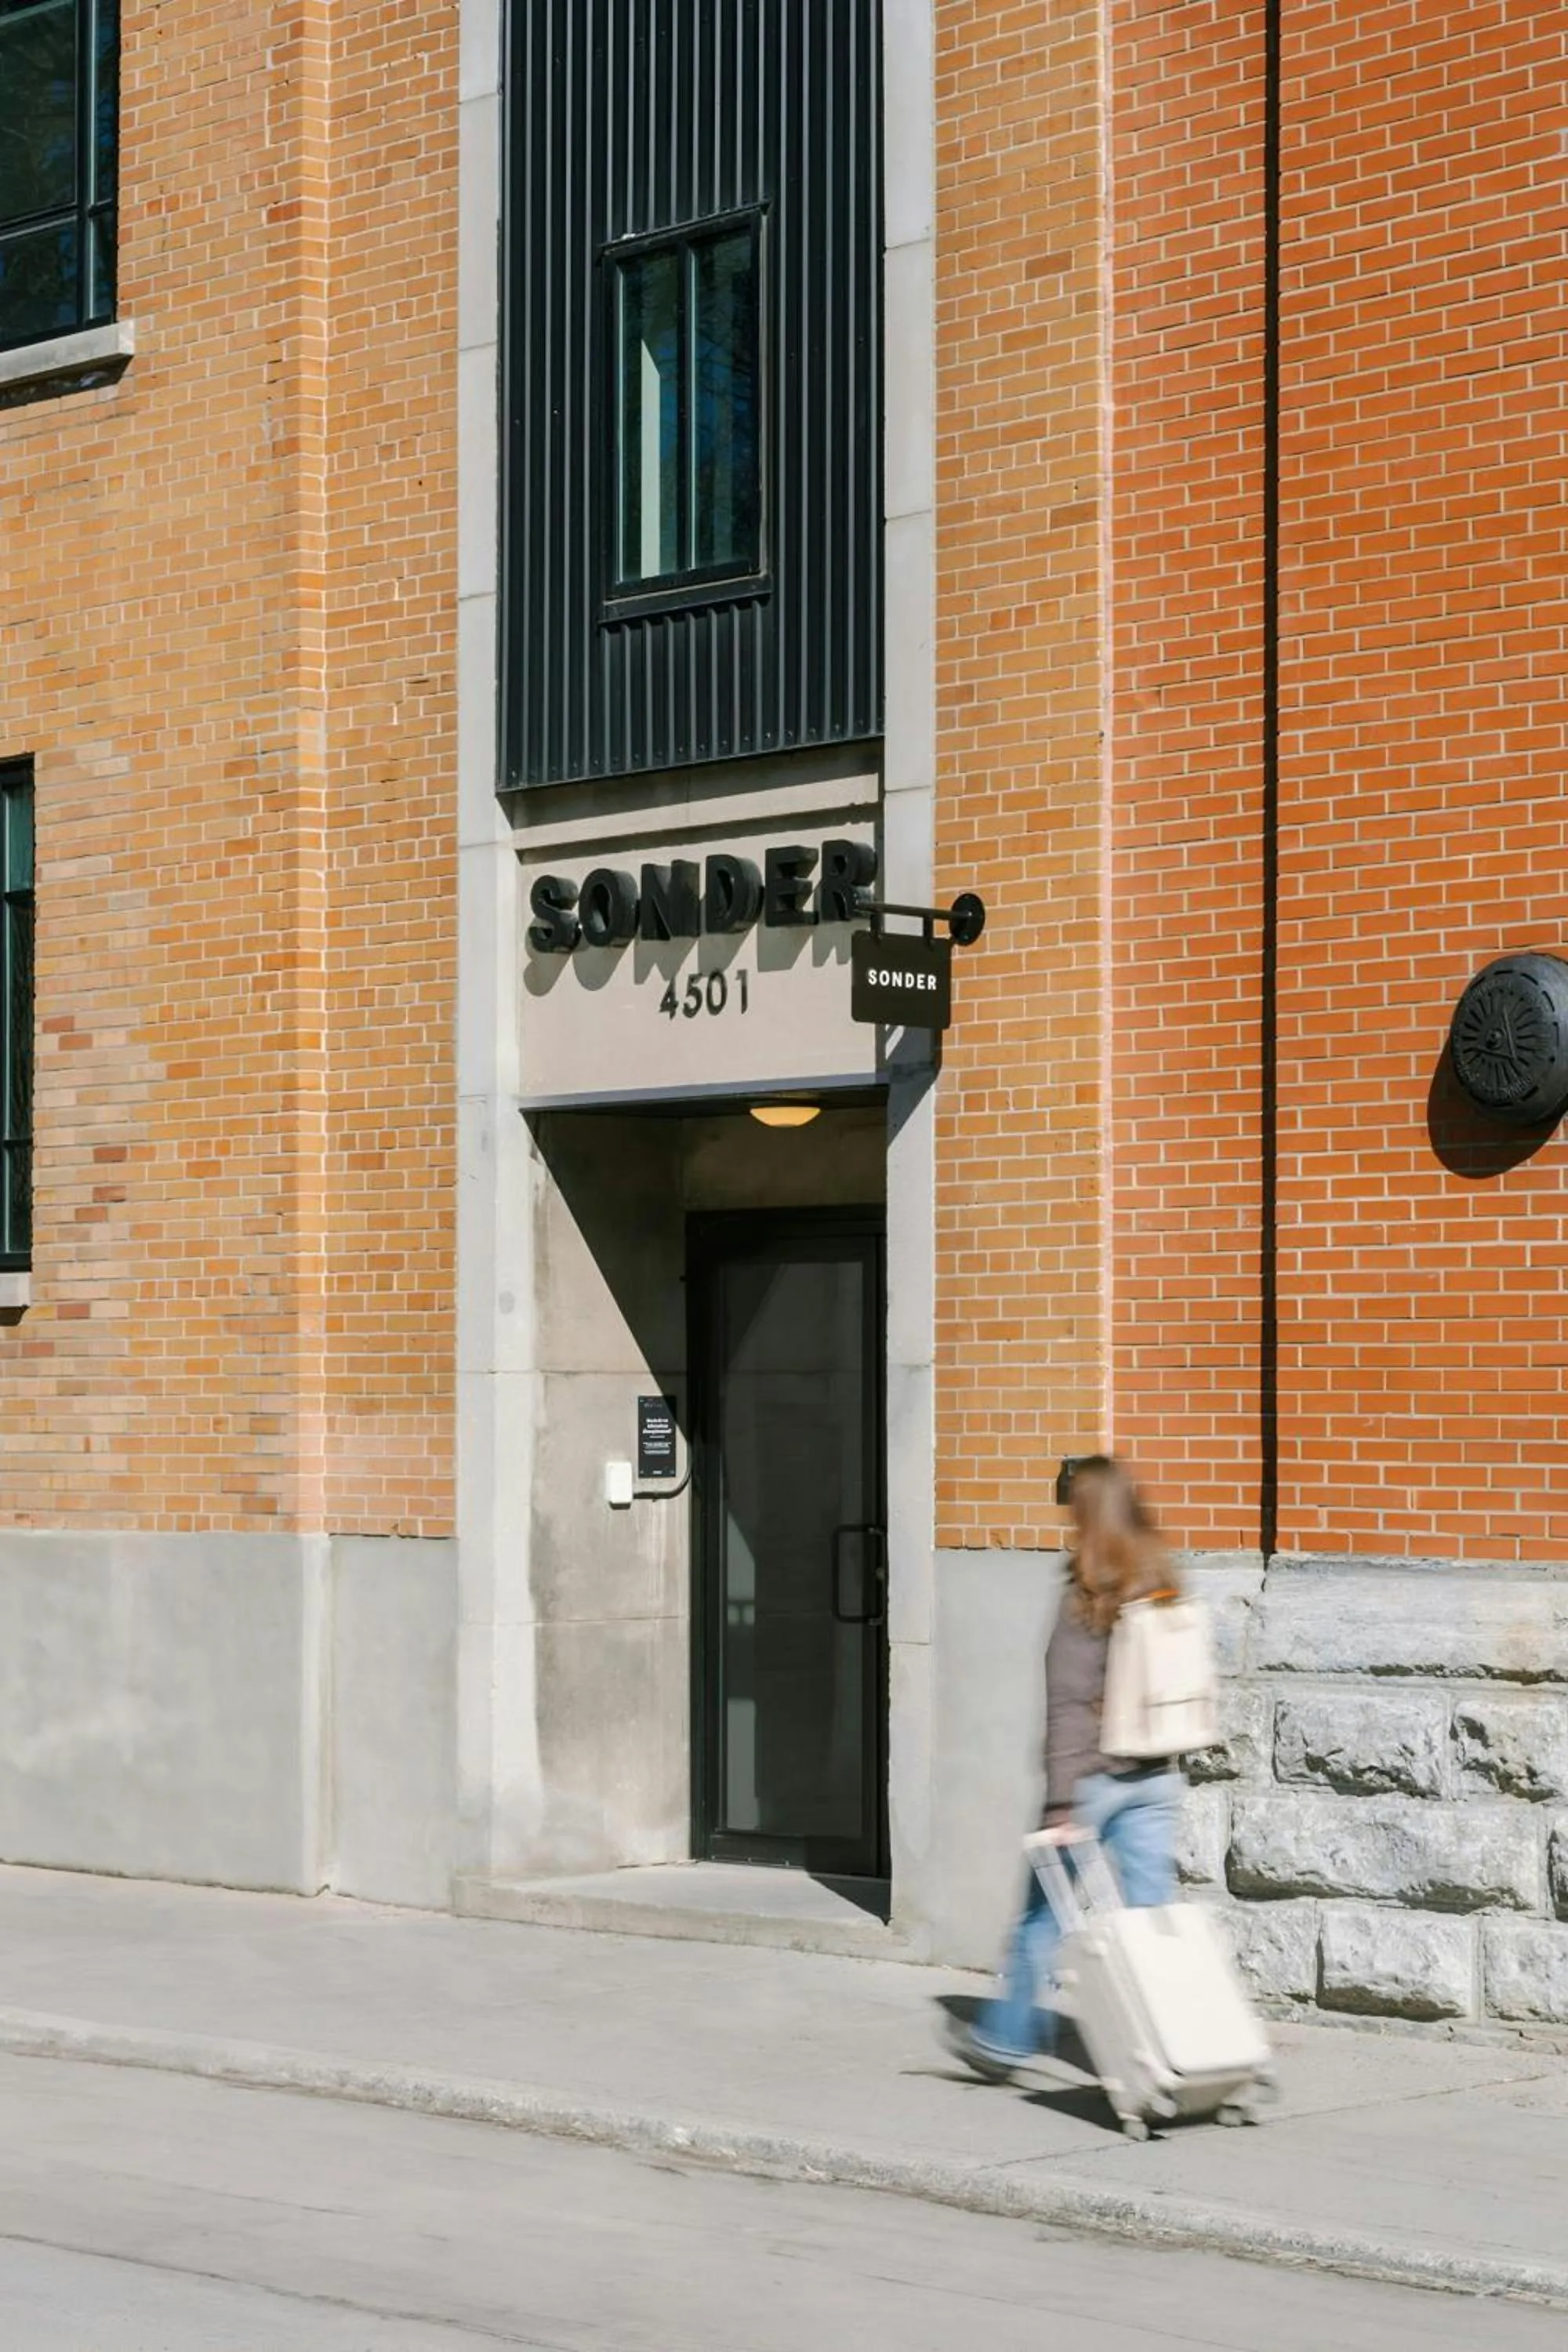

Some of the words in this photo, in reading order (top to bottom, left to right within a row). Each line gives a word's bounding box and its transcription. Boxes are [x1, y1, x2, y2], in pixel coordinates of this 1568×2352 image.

[528, 839, 877, 953] SONDER
[659, 969, 749, 1019] 4501
[867, 968, 938, 991] SONDER
